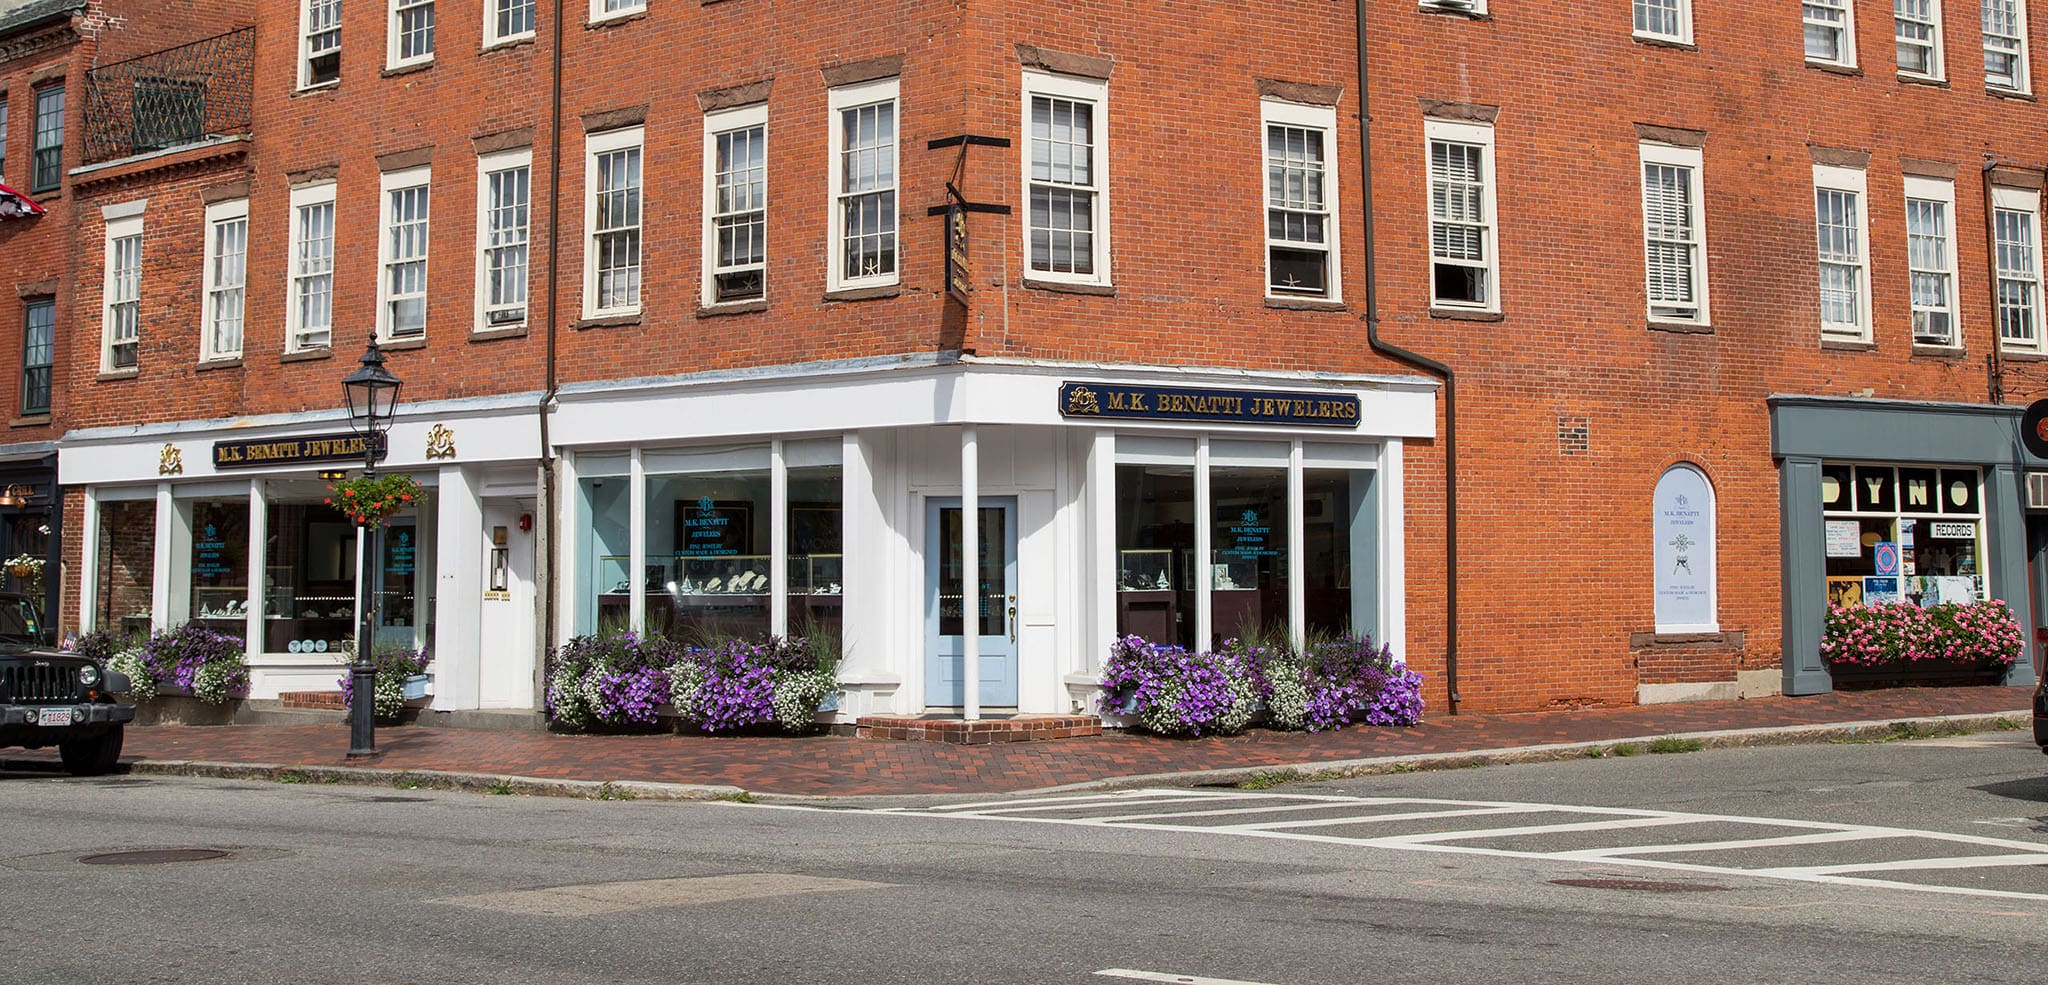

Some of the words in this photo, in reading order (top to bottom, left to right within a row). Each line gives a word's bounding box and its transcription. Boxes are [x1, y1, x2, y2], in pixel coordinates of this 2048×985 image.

[1107, 391, 1149, 412] M.K.
[1157, 394, 1243, 415] BENATTI
[1250, 398, 1356, 419] JEWELERS
[218, 446, 243, 462] M.K.
[246, 442, 300, 461] BENATTI
[304, 437, 369, 457] JEWELER
[1936, 525, 1972, 537] RECORDS
